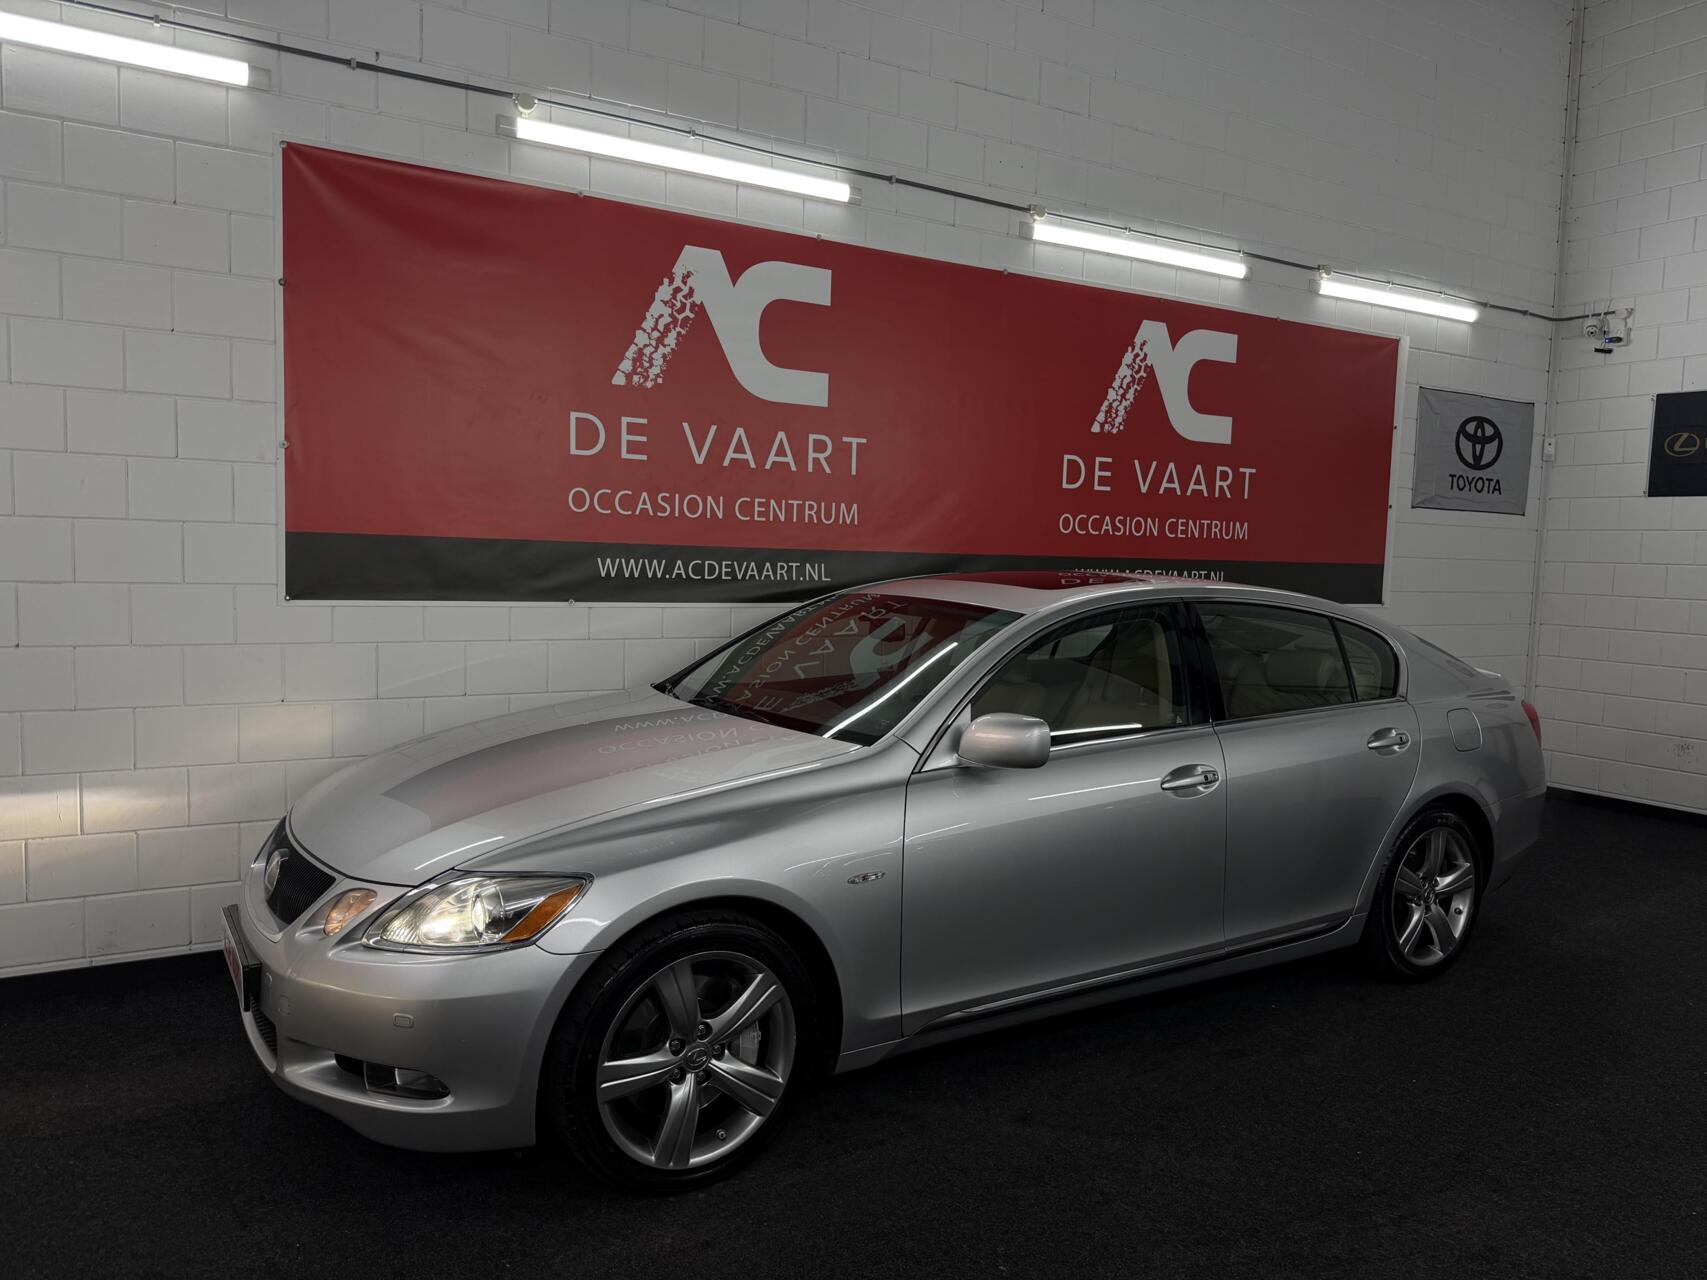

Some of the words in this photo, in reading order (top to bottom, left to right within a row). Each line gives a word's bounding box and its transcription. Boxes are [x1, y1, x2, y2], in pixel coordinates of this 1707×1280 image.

[611, 244, 832, 408] AC
[1090, 319, 1239, 445] AC
[569, 411, 648, 461] DE
[682, 421, 868, 476] VAART
[1062, 454, 1113, 491] DE
[1134, 459, 1257, 500] VAART
[1448, 473, 1502, 495] TOYOTA
[567, 486, 724, 520] OCCASION
[734, 496, 859, 526] CENTRUM
[1058, 512, 1159, 537] OCCASION
[1164, 517, 1249, 540] CENTRUM
[597, 557, 832, 582] WWW.ACDEVAART.NL
